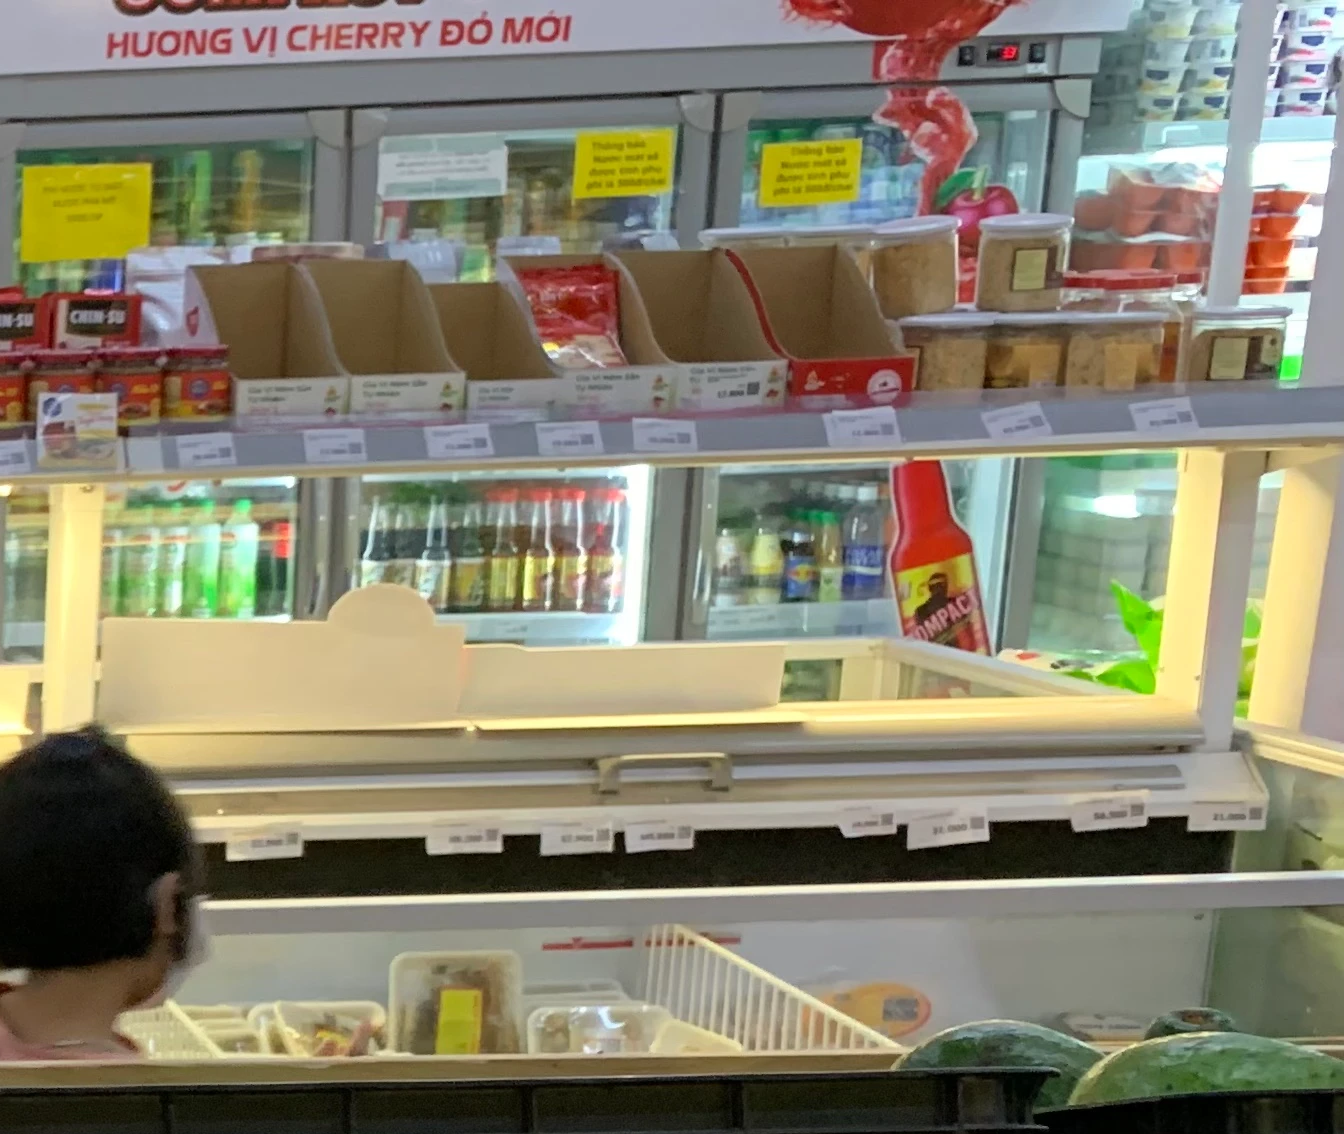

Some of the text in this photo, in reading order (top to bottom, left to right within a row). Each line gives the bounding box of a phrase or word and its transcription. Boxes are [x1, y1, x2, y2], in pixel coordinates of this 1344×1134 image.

[243, 26, 278, 57] VỊ
[286, 20, 432, 51] CHERRY
[439, 11, 493, 46] ĐỎ
[502, 10, 573, 44] MỚI
[70, 309, 125, 325] CHIN-SU
